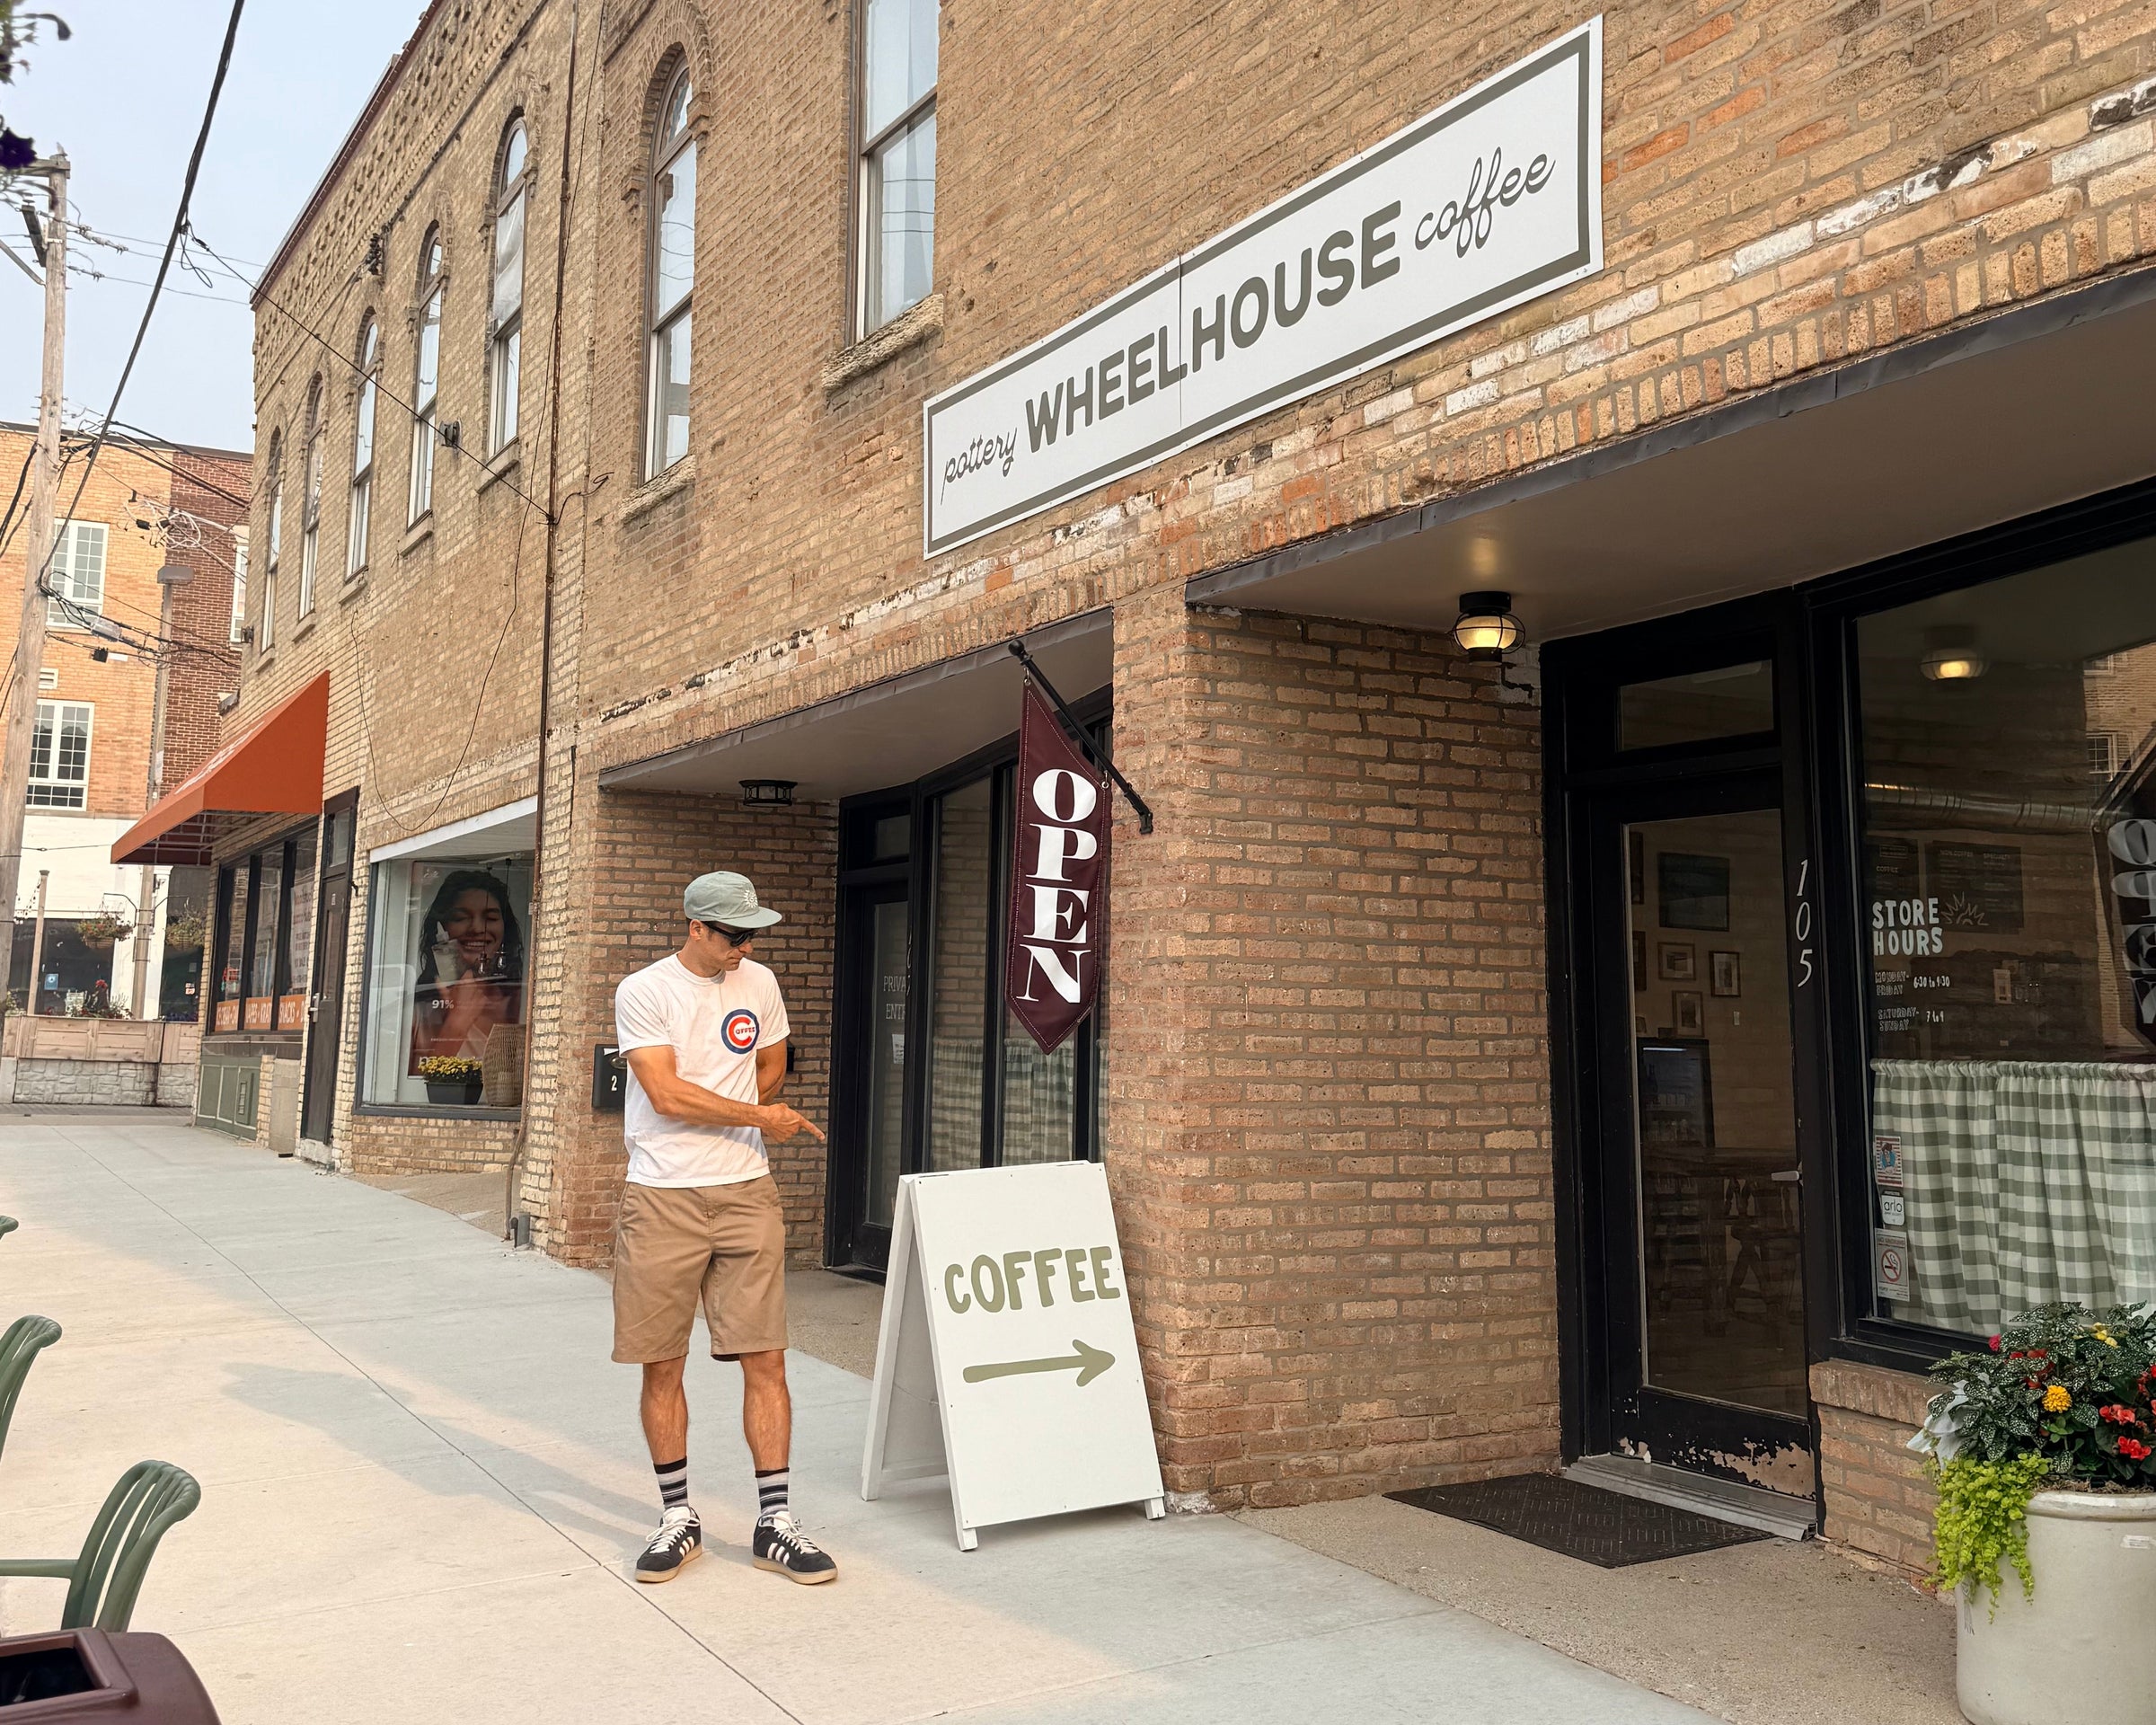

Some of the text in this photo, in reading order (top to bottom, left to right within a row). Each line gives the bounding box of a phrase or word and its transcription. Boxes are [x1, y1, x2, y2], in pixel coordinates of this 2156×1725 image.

[941, 146, 1556, 506] pottery WHEELHOUSE coffee
[1016, 768, 1098, 1004] OPEN
[1796, 859, 1813, 988] 105
[1872, 898, 1940, 929] STORE
[1873, 926, 1943, 956] HOURS
[431, 999, 455, 1010] 91%
[1926, 1011, 1931, 1022] 7
[611, 1075, 618, 1092] 2
[1883, 1199, 1903, 1213] arlo
[944, 1245, 1121, 1314] COFFEE
